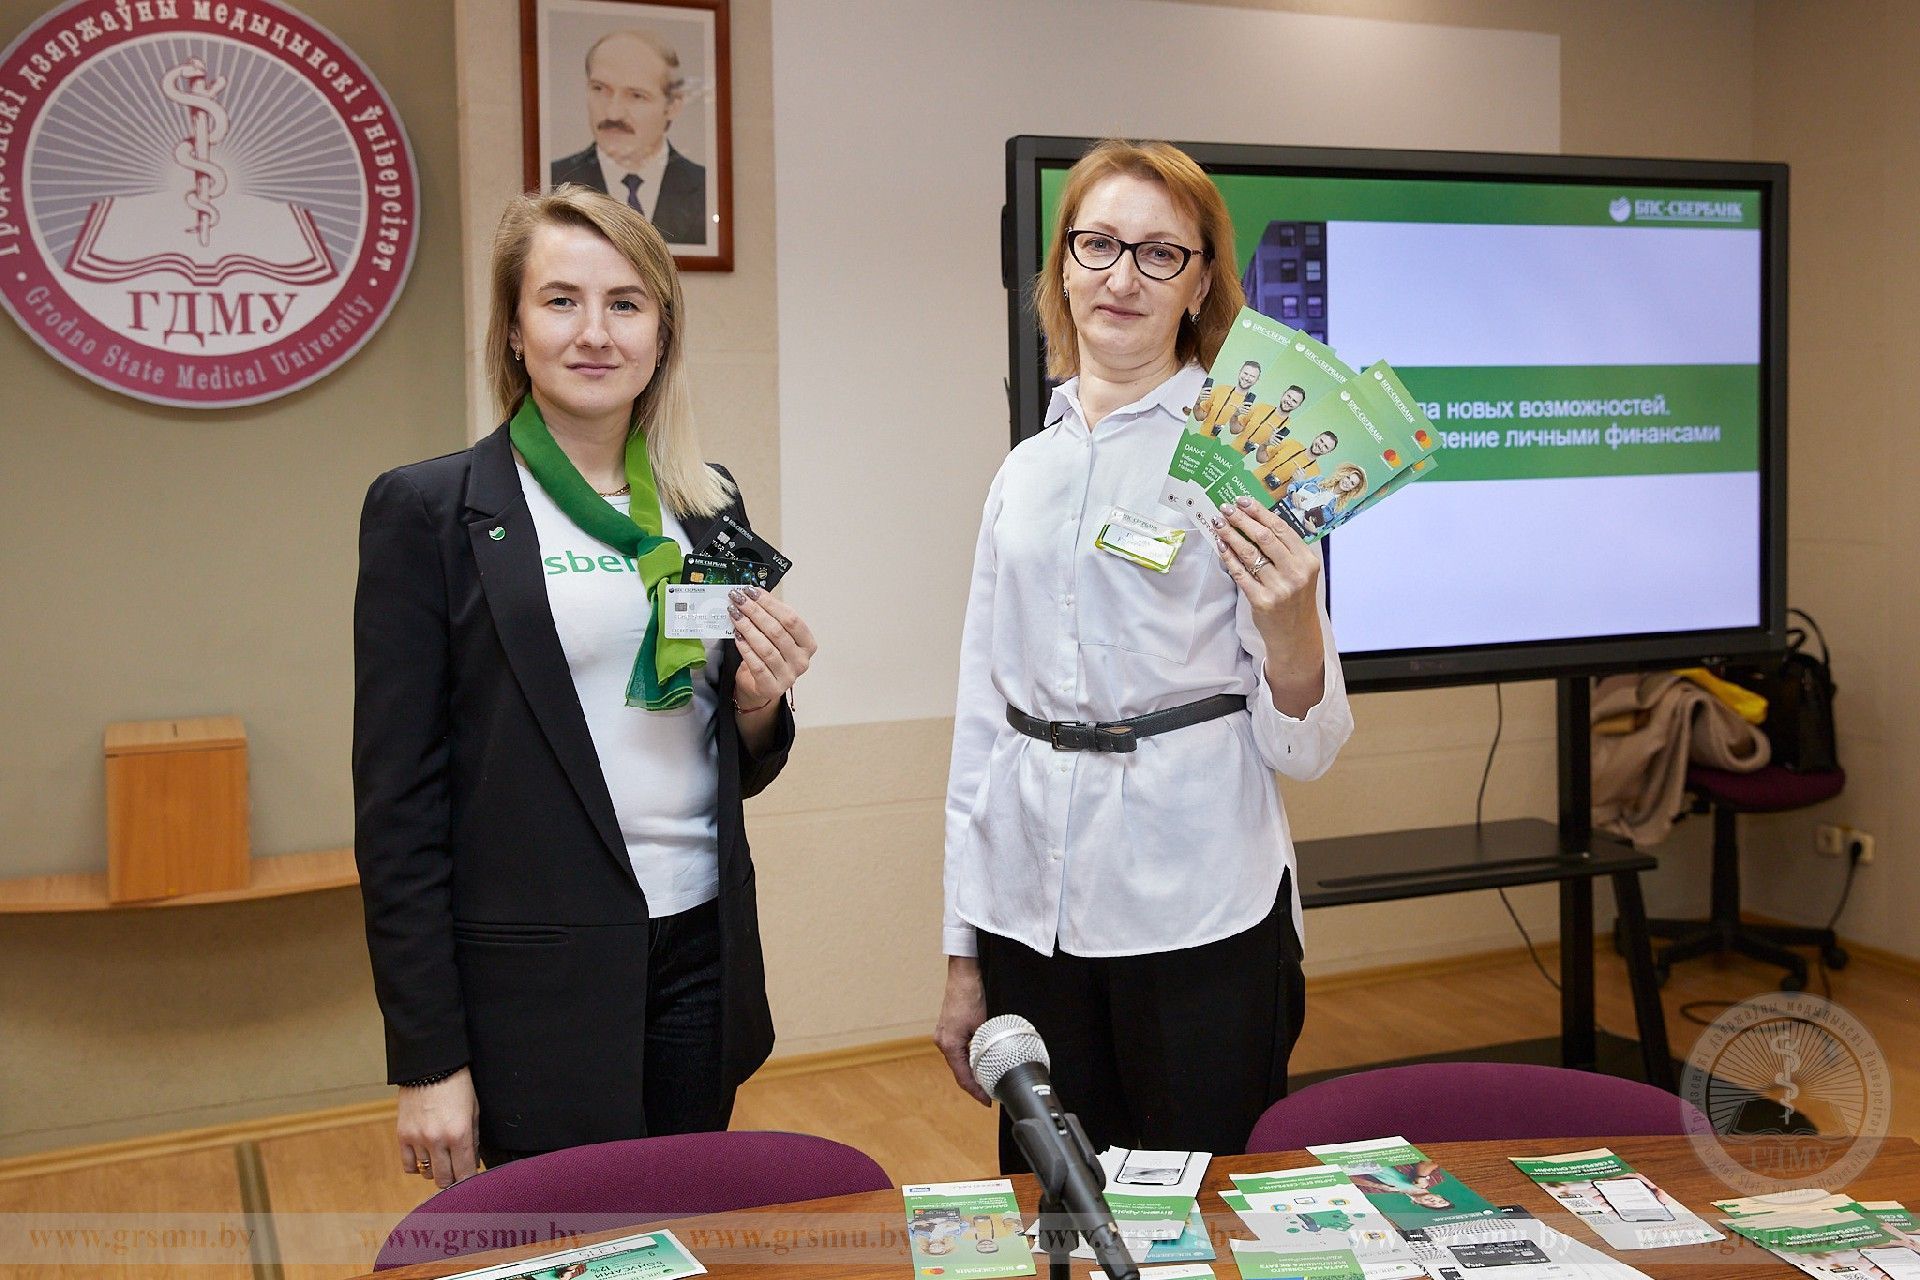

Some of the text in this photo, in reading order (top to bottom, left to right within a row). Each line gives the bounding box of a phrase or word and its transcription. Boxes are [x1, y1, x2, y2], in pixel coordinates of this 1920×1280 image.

[192, 0, 367, 104] медыцынскі
[127, 289, 298, 347] ГДМУ
[26, 284, 375, 391] Grodno State Medical University
[1447, 400, 1514, 419] новых
[1518, 394, 1670, 419] возможностей.
[1504, 427, 1600, 449] личными
[1604, 422, 1721, 450] финансами
[543, 550, 639, 575] sber
[772, 552, 789, 570] VISA
[590, 1265, 611, 1274] 12%
[595, 1261, 663, 1279] БОНУСАМИ
